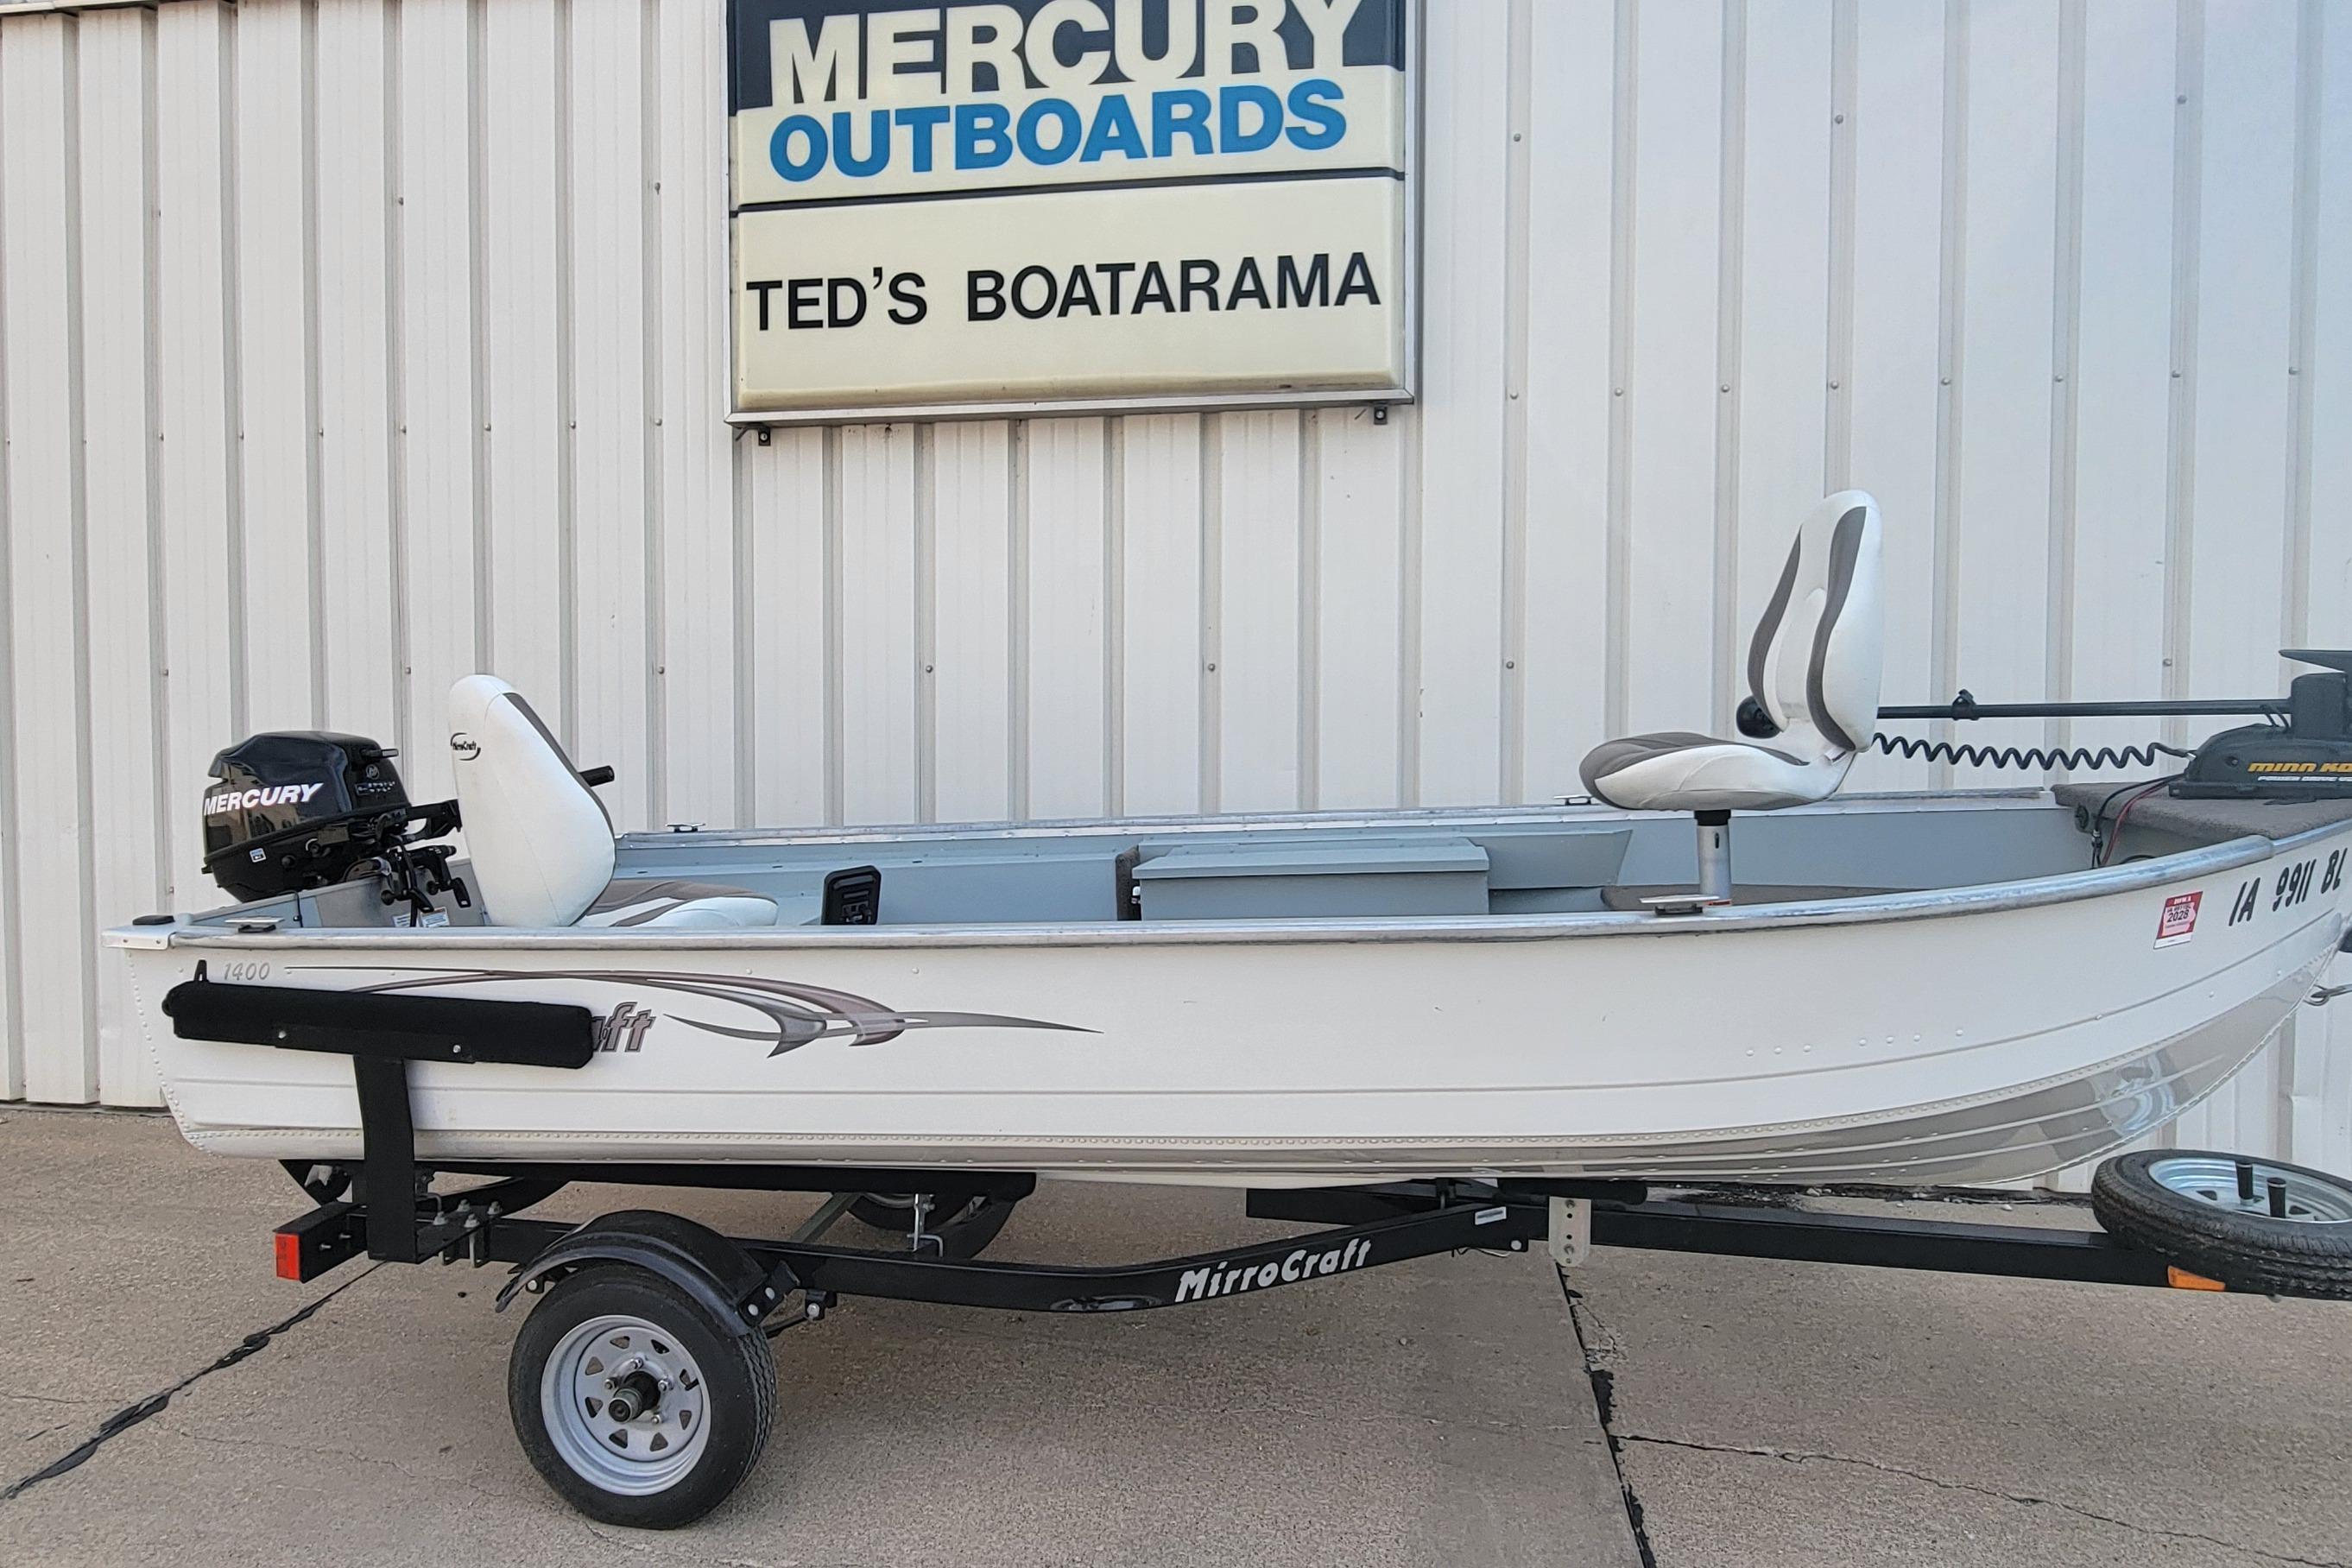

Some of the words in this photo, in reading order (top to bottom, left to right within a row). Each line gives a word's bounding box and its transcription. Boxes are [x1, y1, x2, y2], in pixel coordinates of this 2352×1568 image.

[768, 0, 1366, 104] MERCURY
[768, 79, 1347, 182] OUTBOARDS
[746, 266, 928, 331] TED'S
[966, 252, 1381, 322] BOATARAMA
[203, 782, 325, 816] MERCURY
[2229, 876, 2261, 926] IA
[2272, 858, 2317, 912] 9911
[224, 962, 270, 981] 1400
[1173, 1236, 1373, 1304] MirroCraft
